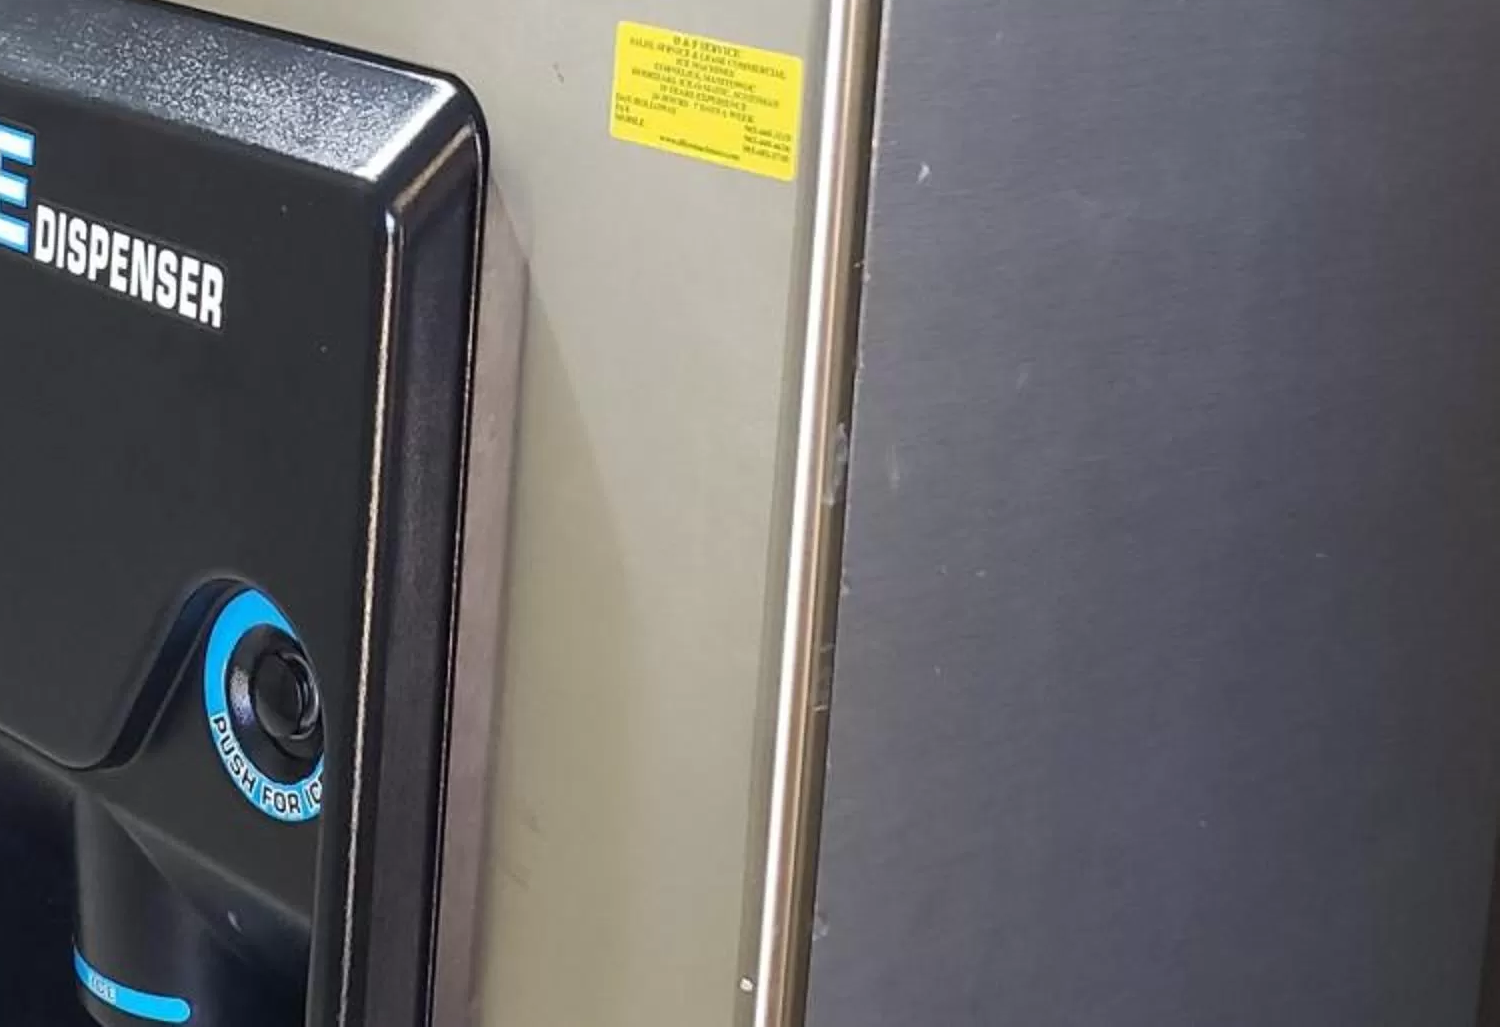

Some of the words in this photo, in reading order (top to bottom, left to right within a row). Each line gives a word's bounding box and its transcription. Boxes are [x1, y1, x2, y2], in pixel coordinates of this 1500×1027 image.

[33, 203, 226, 329] DISPENSER
[213, 716, 257, 794] PUSH
[262, 785, 302, 814] FOR
[304, 774, 324, 810] IC
